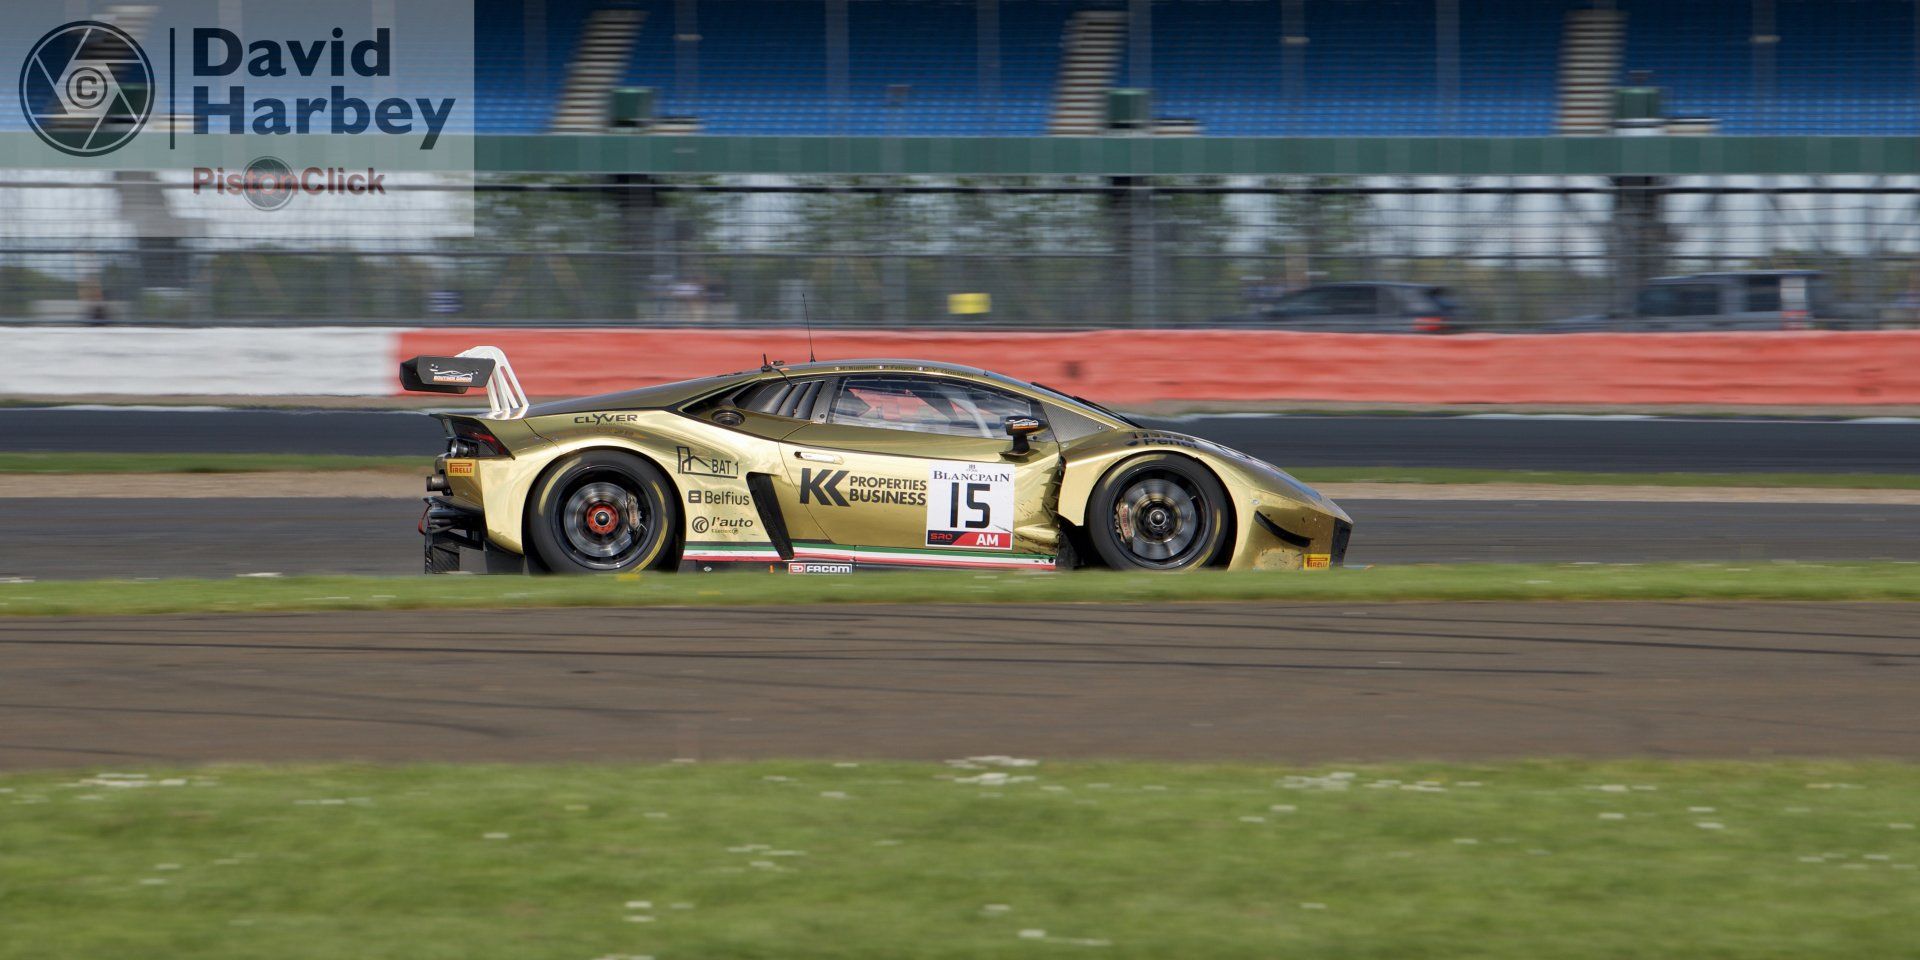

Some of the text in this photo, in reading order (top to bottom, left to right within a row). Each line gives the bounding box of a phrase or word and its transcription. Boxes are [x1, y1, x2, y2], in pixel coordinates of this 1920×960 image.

[574, 413, 638, 425] CLYVER
[449, 463, 473, 473] PIRELLI
[711, 459, 739, 475] BAT 1
[933, 470, 1010, 482] BLANCPAIN
[849, 475, 927, 491] PROPERTIES
[704, 490, 750, 506] Belfius
[849, 489, 927, 506] BUSINESS
[950, 482, 991, 529] 15
[711, 516, 754, 528] l'auto
[975, 533, 999, 547] AM
[806, 565, 851, 573] FACOM
[1306, 557, 1329, 568] PIRELLI
